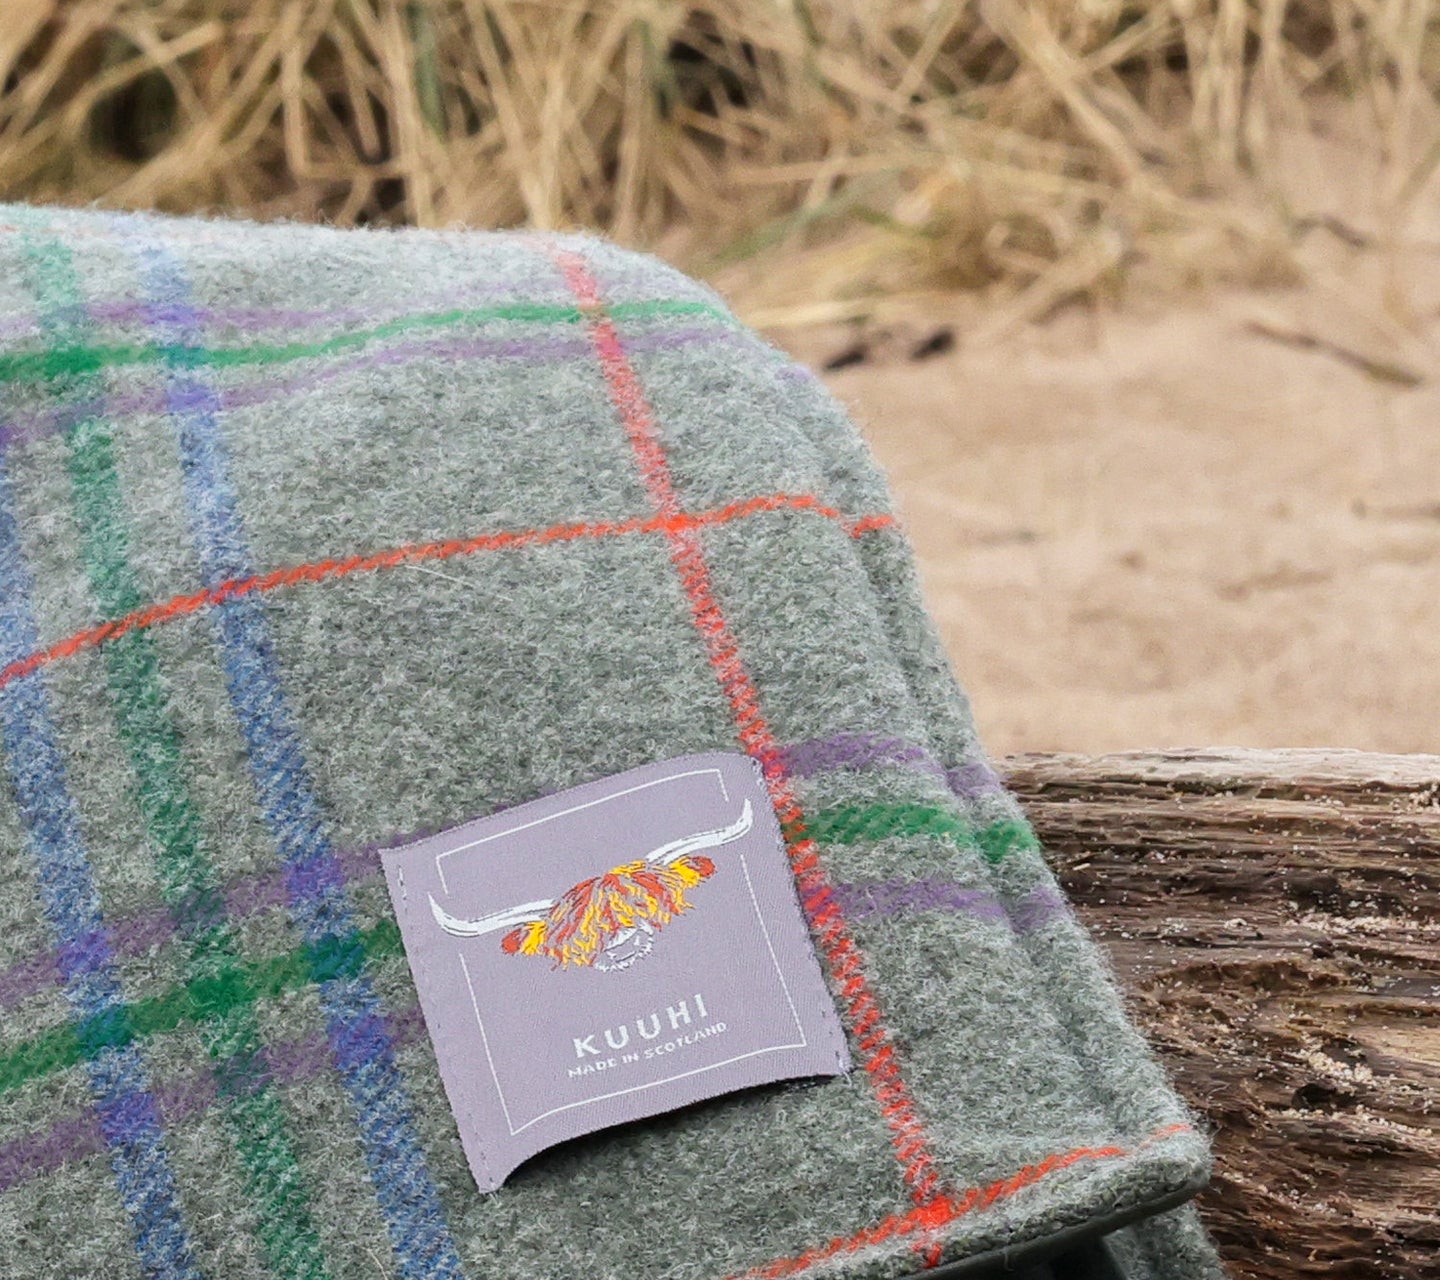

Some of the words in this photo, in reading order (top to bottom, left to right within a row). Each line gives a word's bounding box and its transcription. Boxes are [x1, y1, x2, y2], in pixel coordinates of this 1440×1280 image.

[568, 1058, 618, 1079] MADE
[622, 1053, 639, 1064] IN
[644, 1022, 728, 1059] SCOTLAND
[572, 993, 708, 1058] KUUHI
